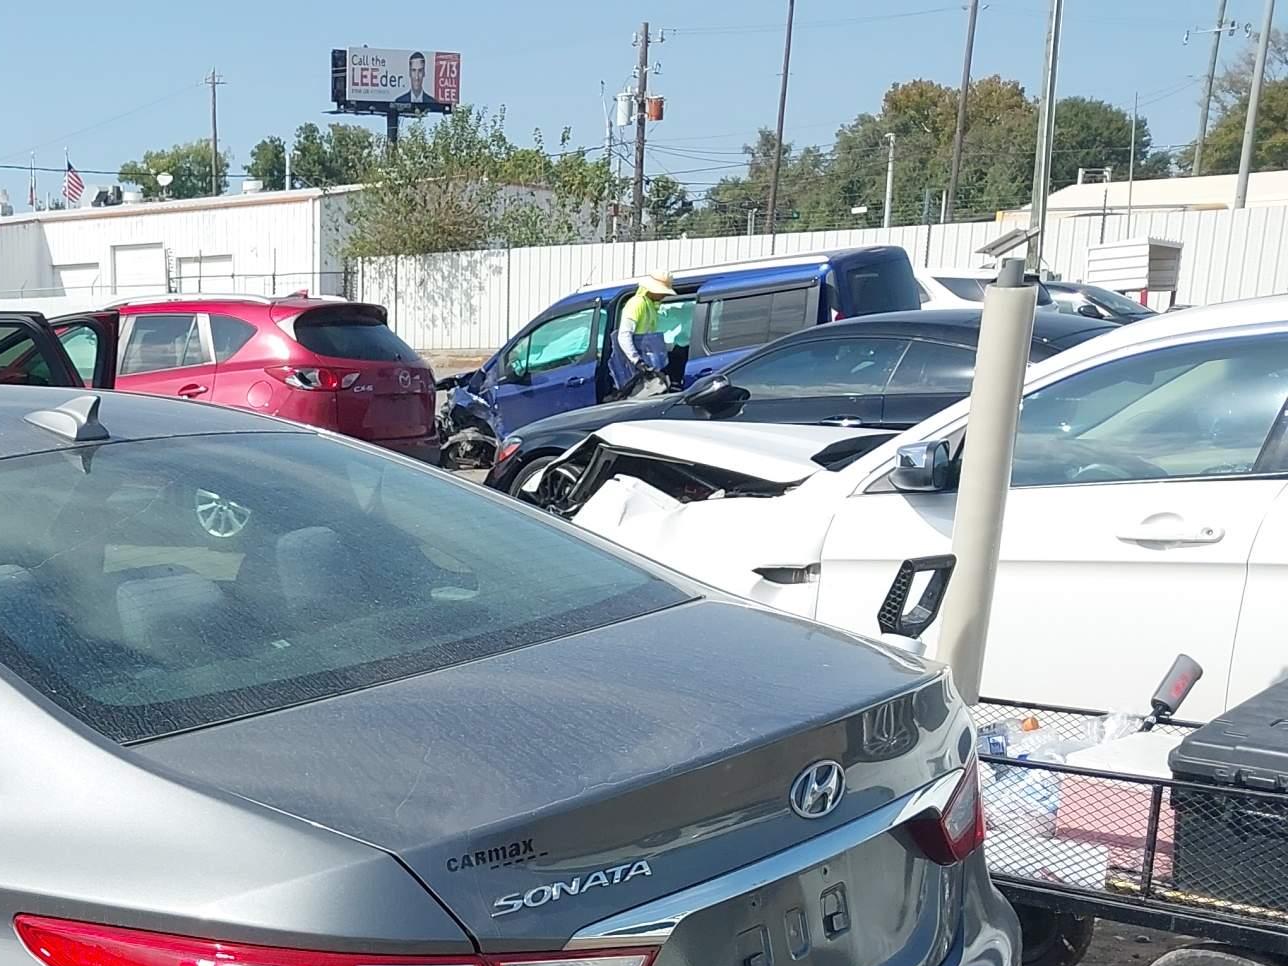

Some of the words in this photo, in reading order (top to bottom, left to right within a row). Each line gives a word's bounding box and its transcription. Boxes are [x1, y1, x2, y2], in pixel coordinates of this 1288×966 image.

[352, 54, 370, 66] Call
[371, 55, 386, 66] the
[439, 61, 457, 78] 713
[352, 67, 405, 88] LEEder.
[439, 78, 457, 88] CALL
[439, 89, 457, 101] LEE
[490, 859, 653, 919] SONATA
